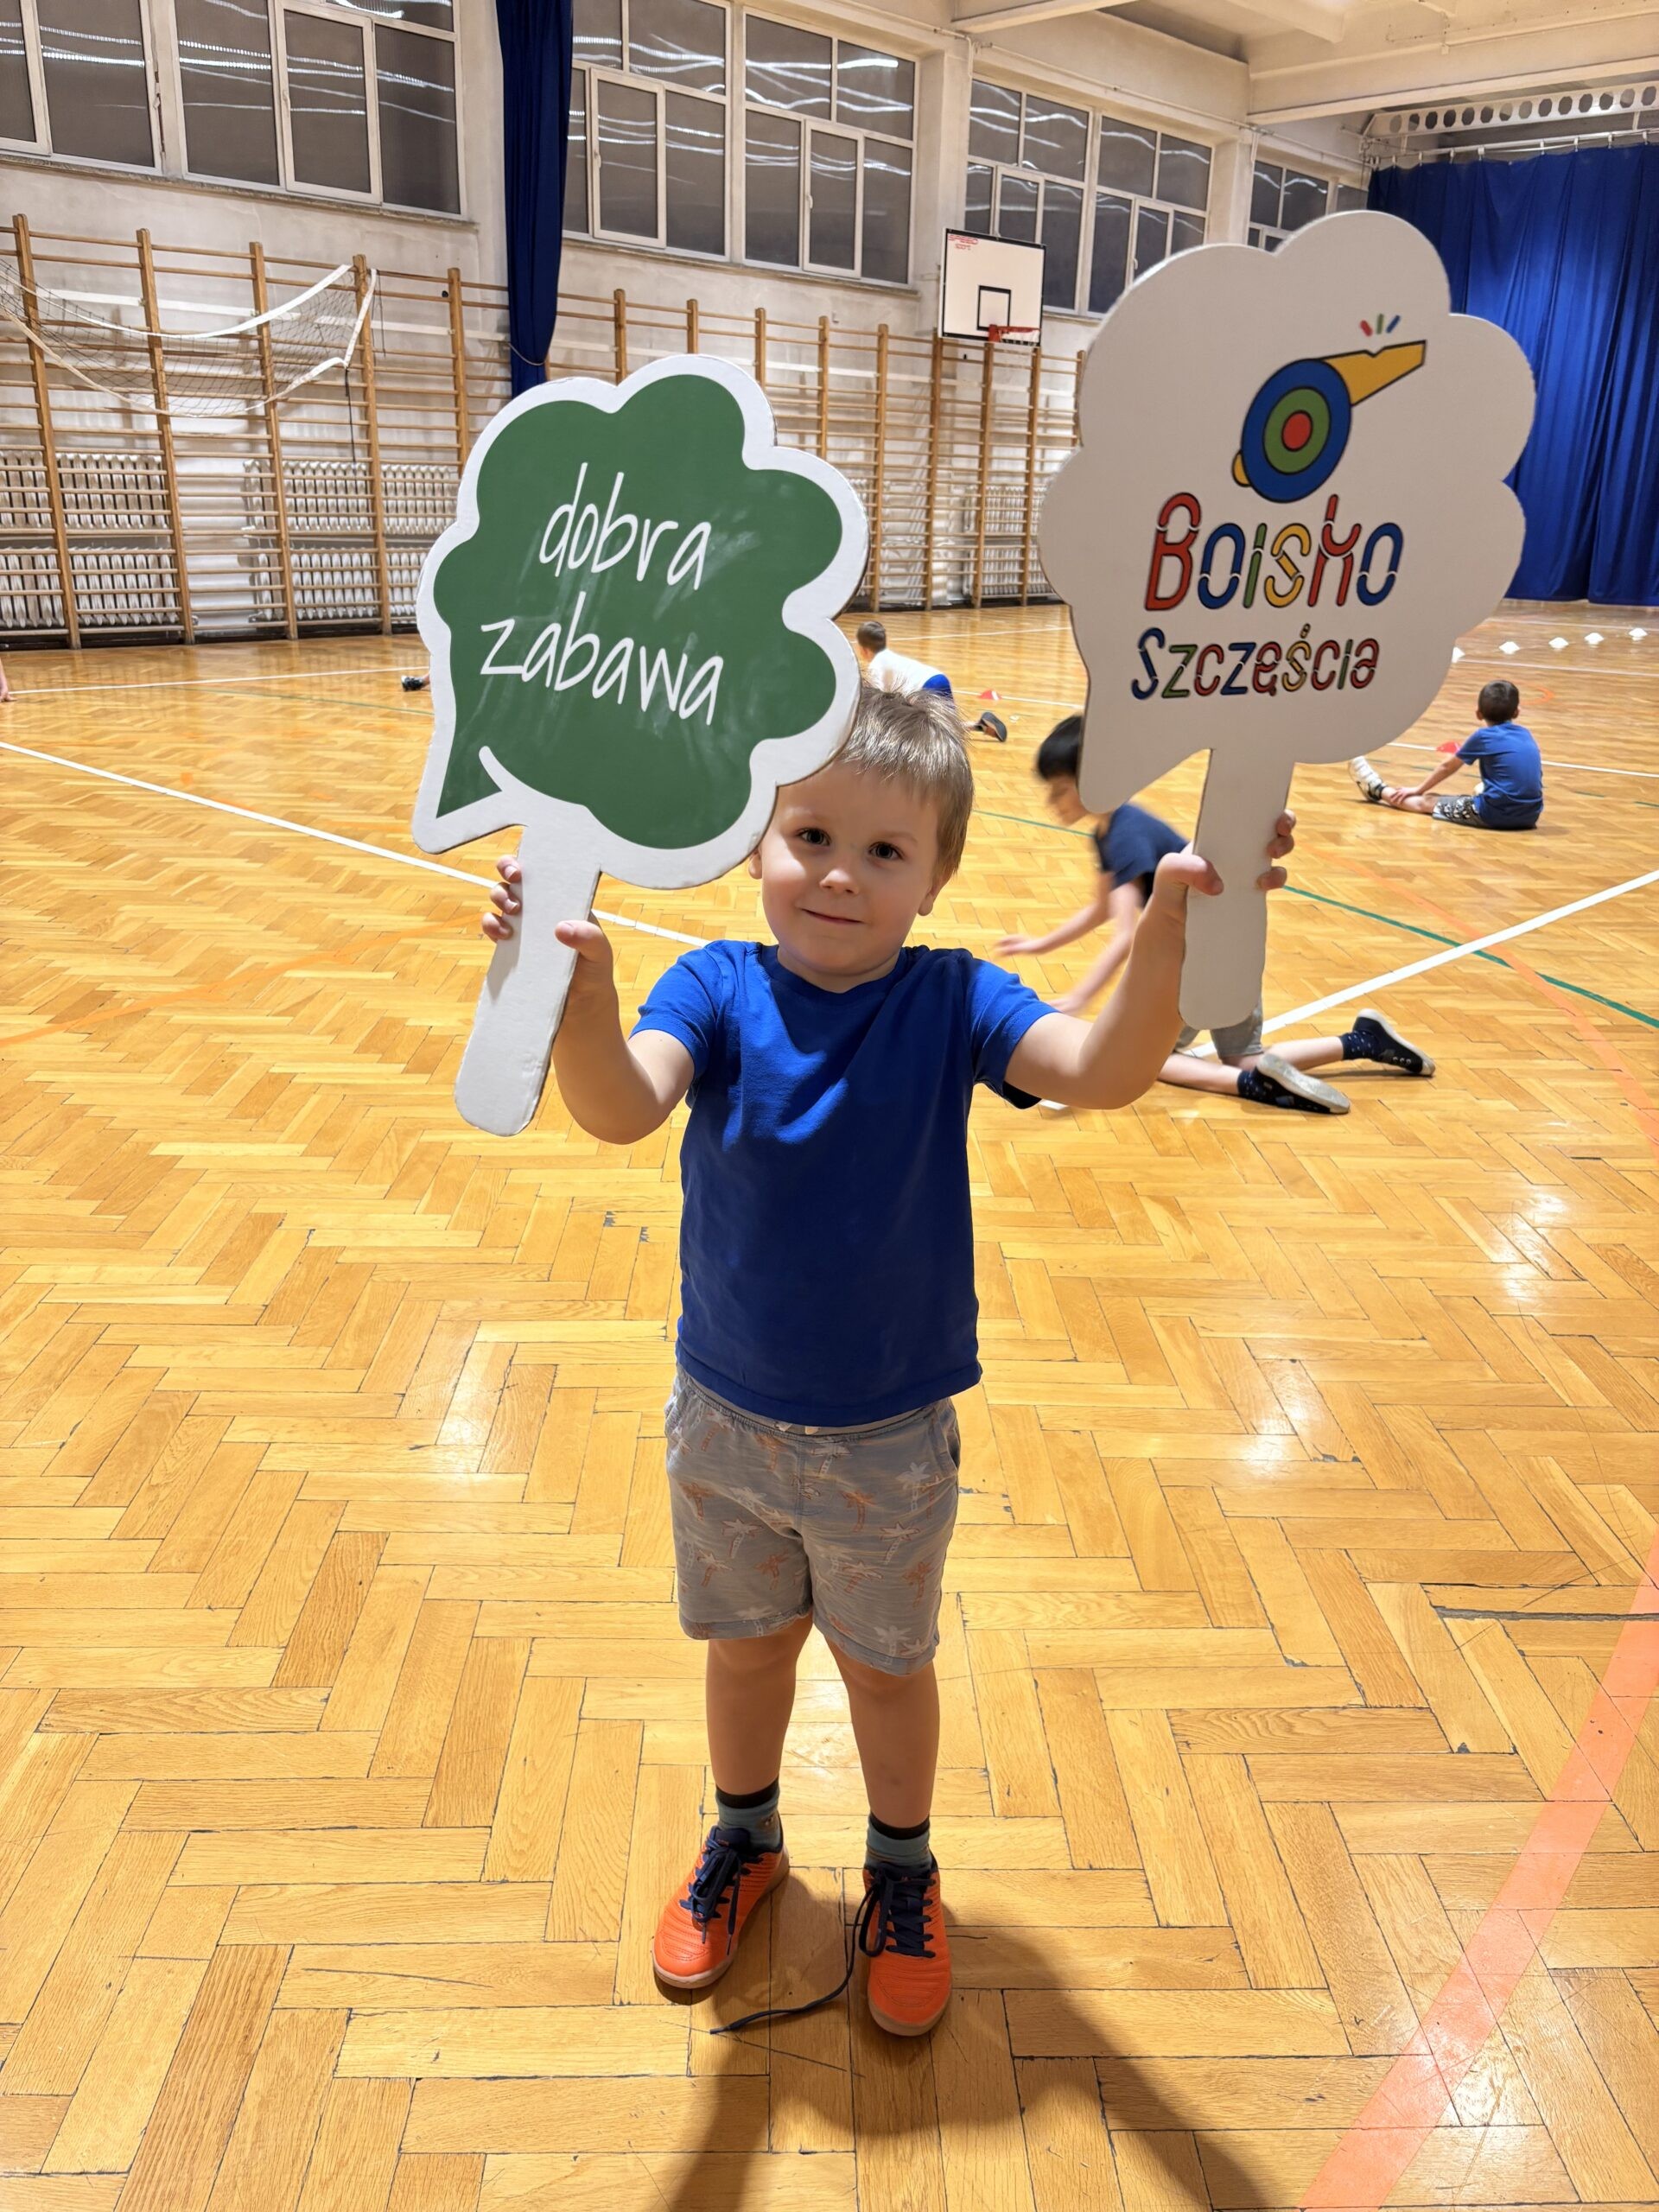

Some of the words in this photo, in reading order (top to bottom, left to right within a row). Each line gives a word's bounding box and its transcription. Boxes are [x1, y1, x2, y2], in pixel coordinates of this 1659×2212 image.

[538, 461, 712, 591] dobra
[1143, 491, 1404, 613] Boisko
[480, 590, 724, 726] zabawa
[1130, 622, 1381, 701] Szczęścia
